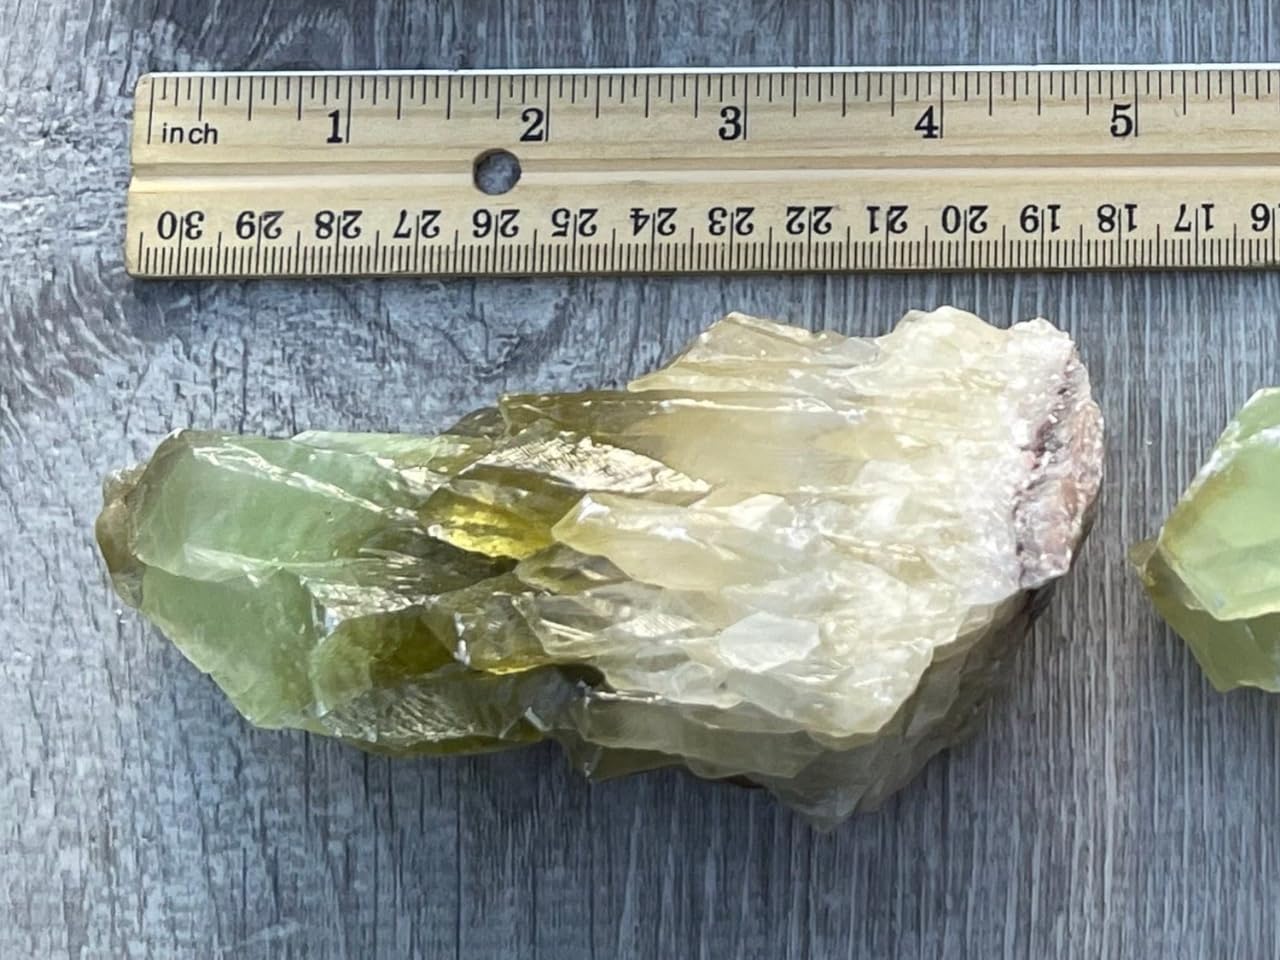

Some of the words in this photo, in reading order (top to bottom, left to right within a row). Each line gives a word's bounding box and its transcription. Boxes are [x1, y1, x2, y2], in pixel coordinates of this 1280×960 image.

[162, 123, 218, 144] inch
[327, 110, 343, 143] 1
[520, 108, 545, 142] 2
[719, 106, 743, 140] 3
[914, 105, 939, 138] 4
[1110, 104, 1135, 137] 5
[157, 211, 205, 239] 30
[235, 211, 283, 239] 29
[314, 210, 362, 238] 28
[393, 209, 442, 237] 27
[472, 208, 520, 237] 26
[551, 208, 598, 236] 25
[629, 207, 677, 236] 24
[707, 206, 755, 234] 23
[785, 206, 833, 234] 22
[866, 205, 909, 234] 21
[942, 205, 988, 233] 20
[1020, 204, 1061, 233] 19
[1098, 204, 1139, 232] 18
[1175, 203, 1215, 231] 17
